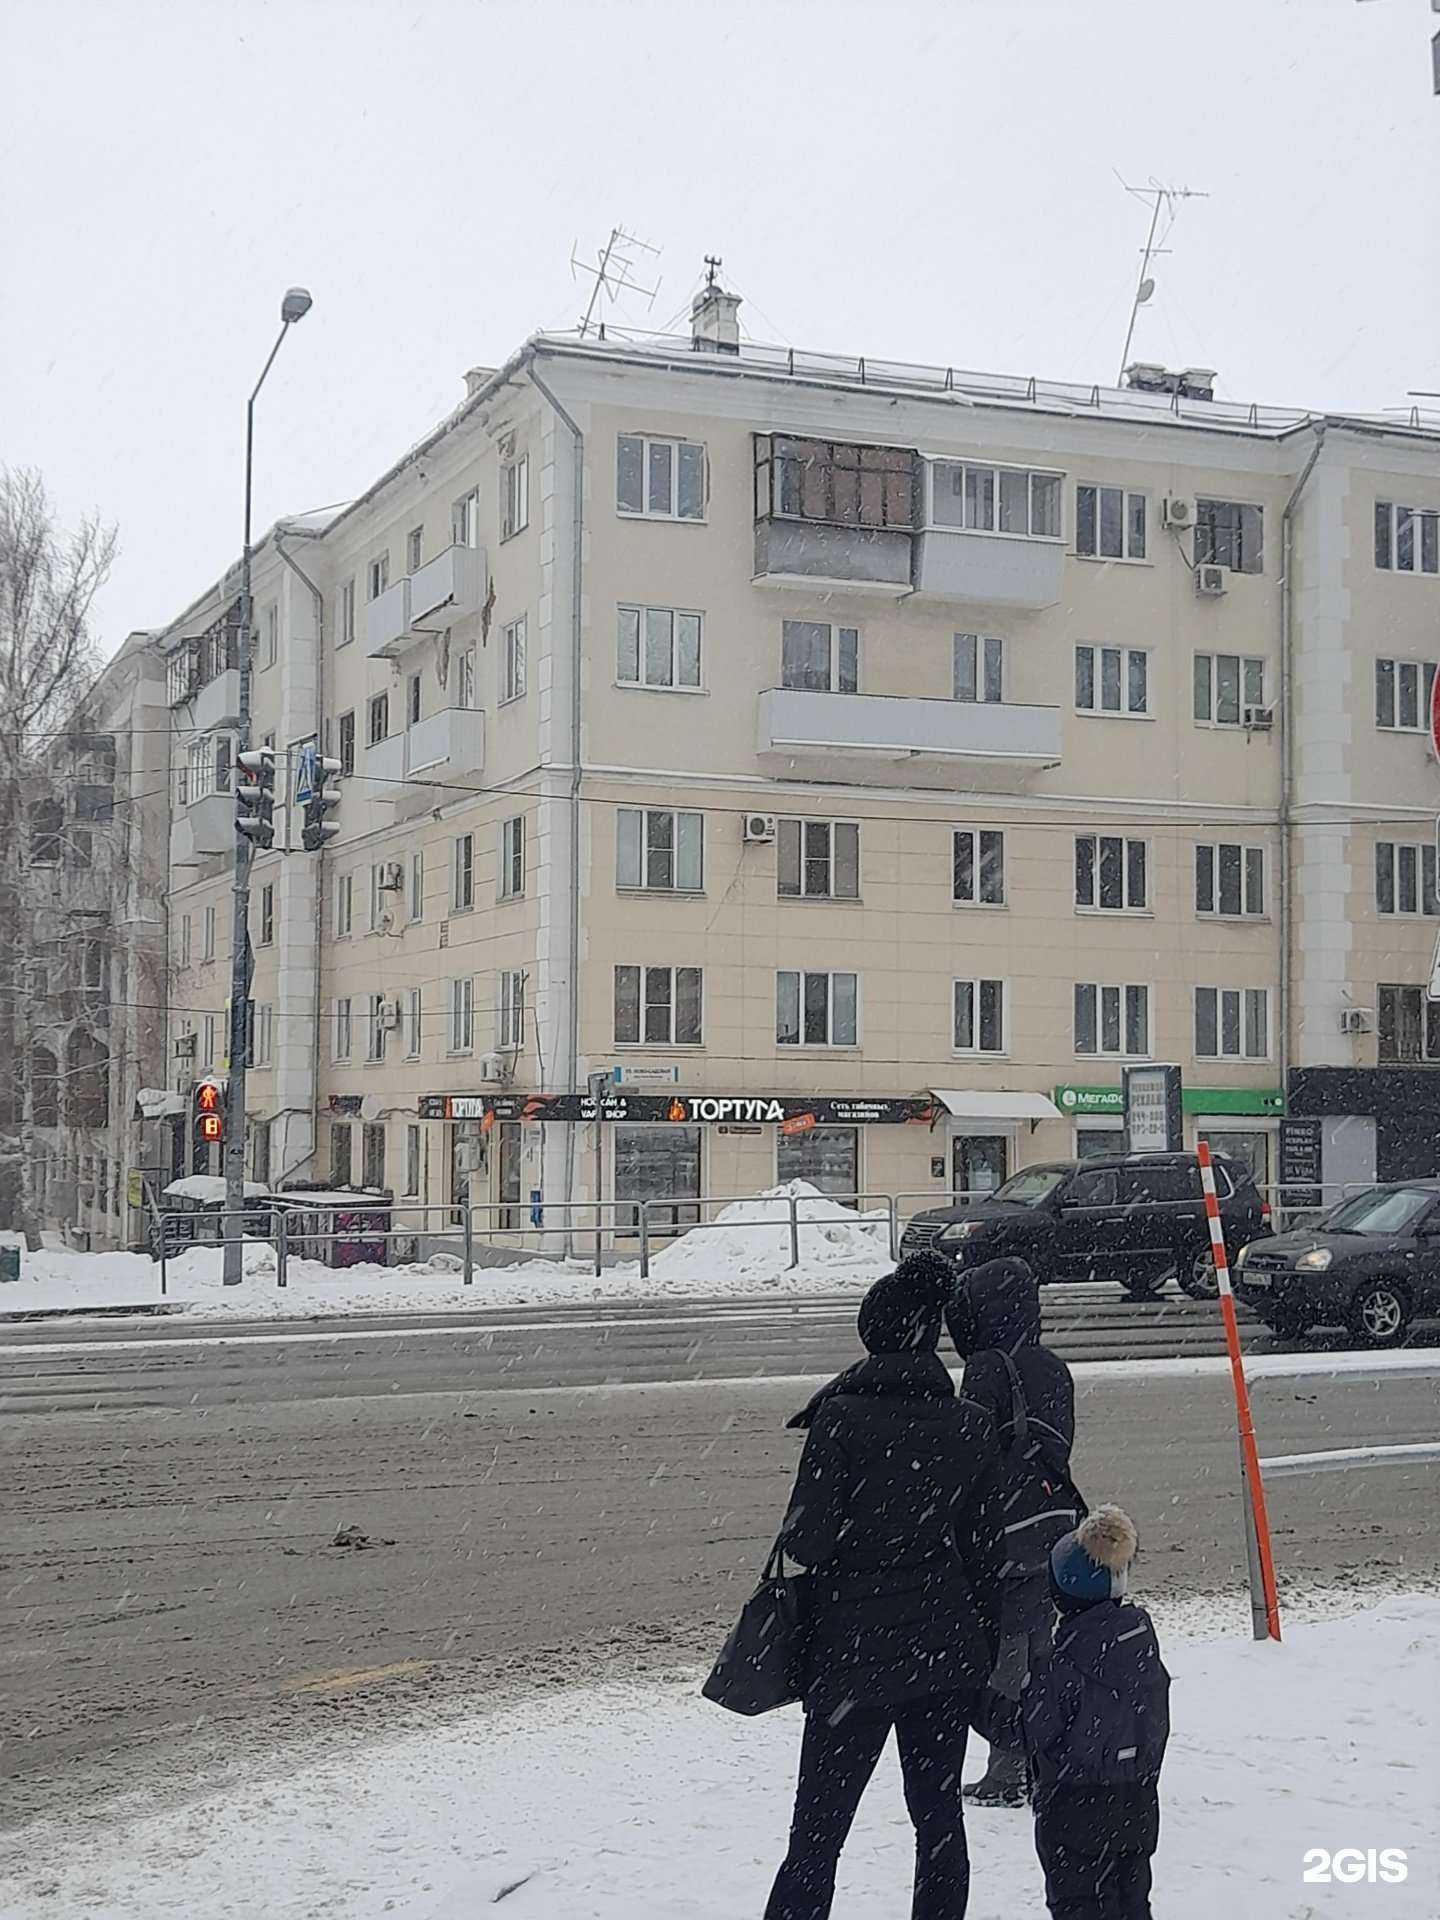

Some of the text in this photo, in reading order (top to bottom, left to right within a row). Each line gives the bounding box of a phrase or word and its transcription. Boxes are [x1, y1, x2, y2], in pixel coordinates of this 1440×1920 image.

[620, 1098, 627, 1107] &
[1078, 1094, 1123, 1104] МЕГАФ
[688, 1098, 784, 1120] ТОРТУГА
[581, 1110, 598, 1118] VAP
